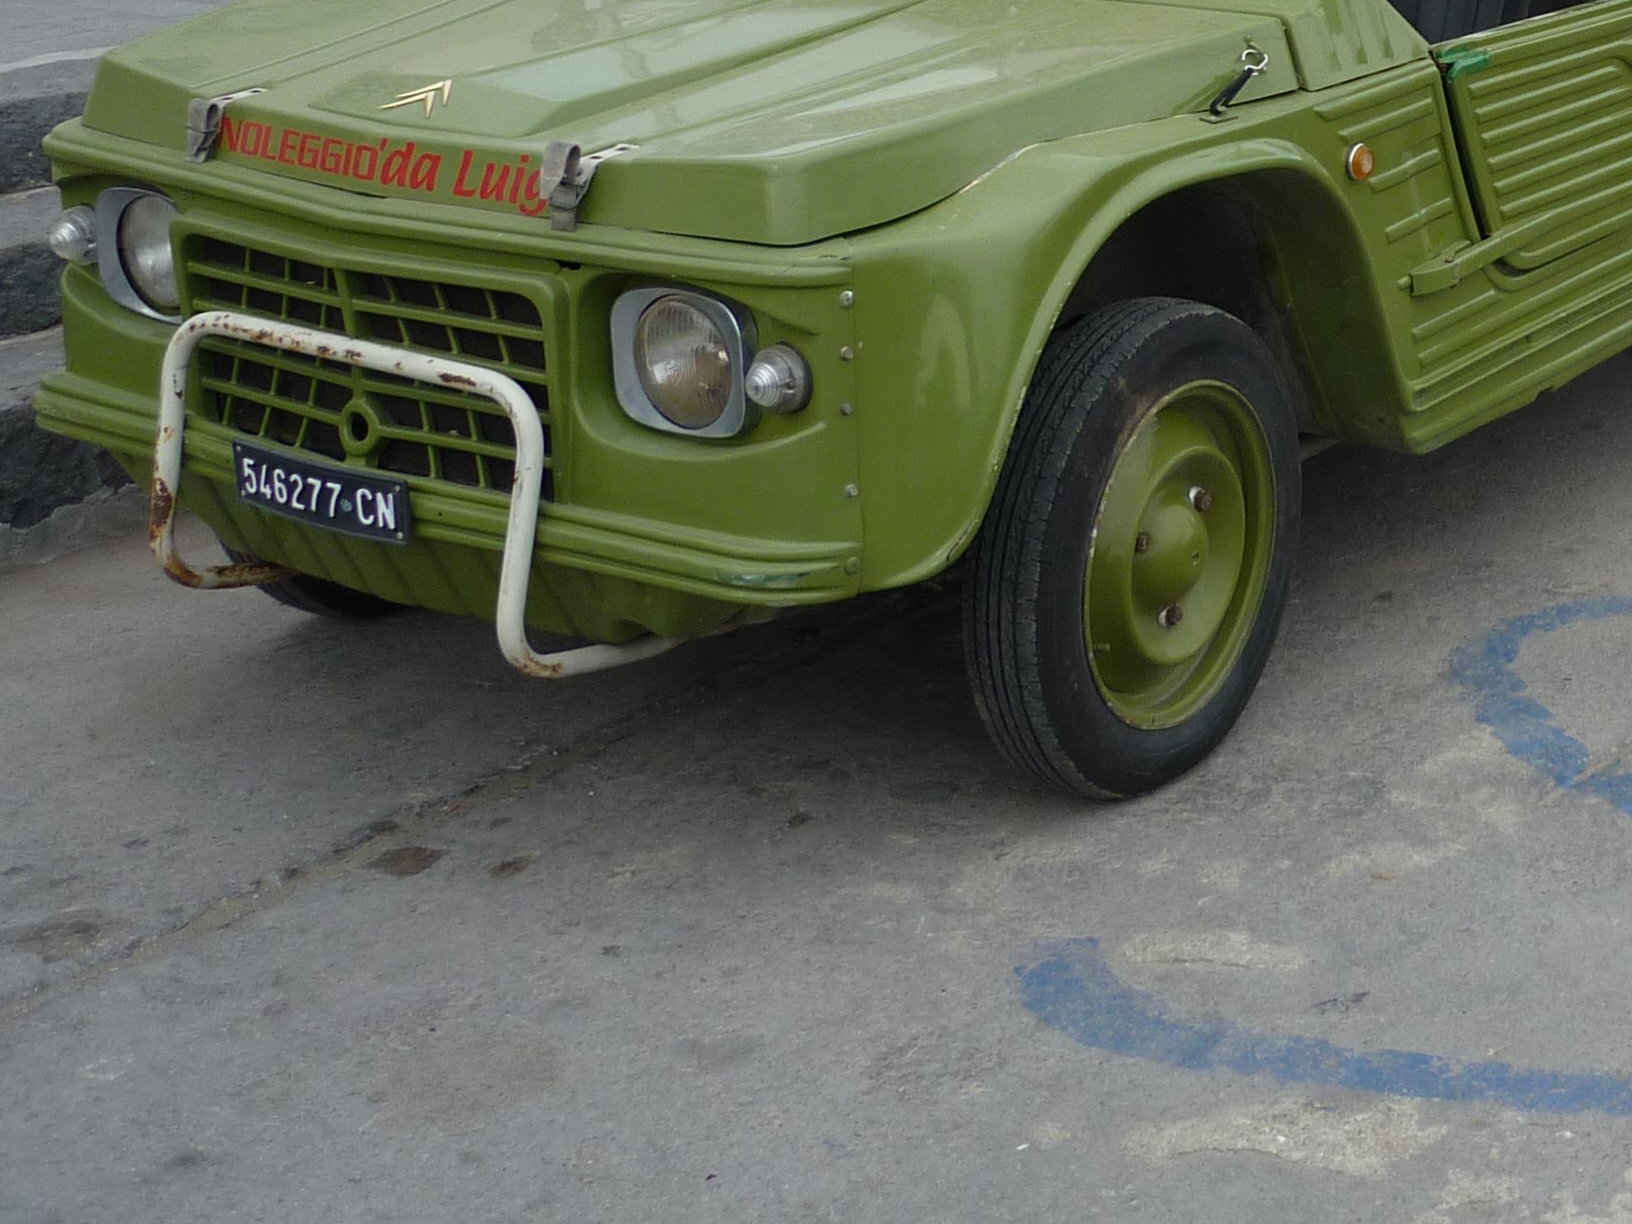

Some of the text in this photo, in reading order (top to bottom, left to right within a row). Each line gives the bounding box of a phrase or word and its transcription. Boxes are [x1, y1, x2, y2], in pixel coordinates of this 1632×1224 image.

[452, 149, 547, 217] Luig
[242, 457, 396, 530] 546277 CN
